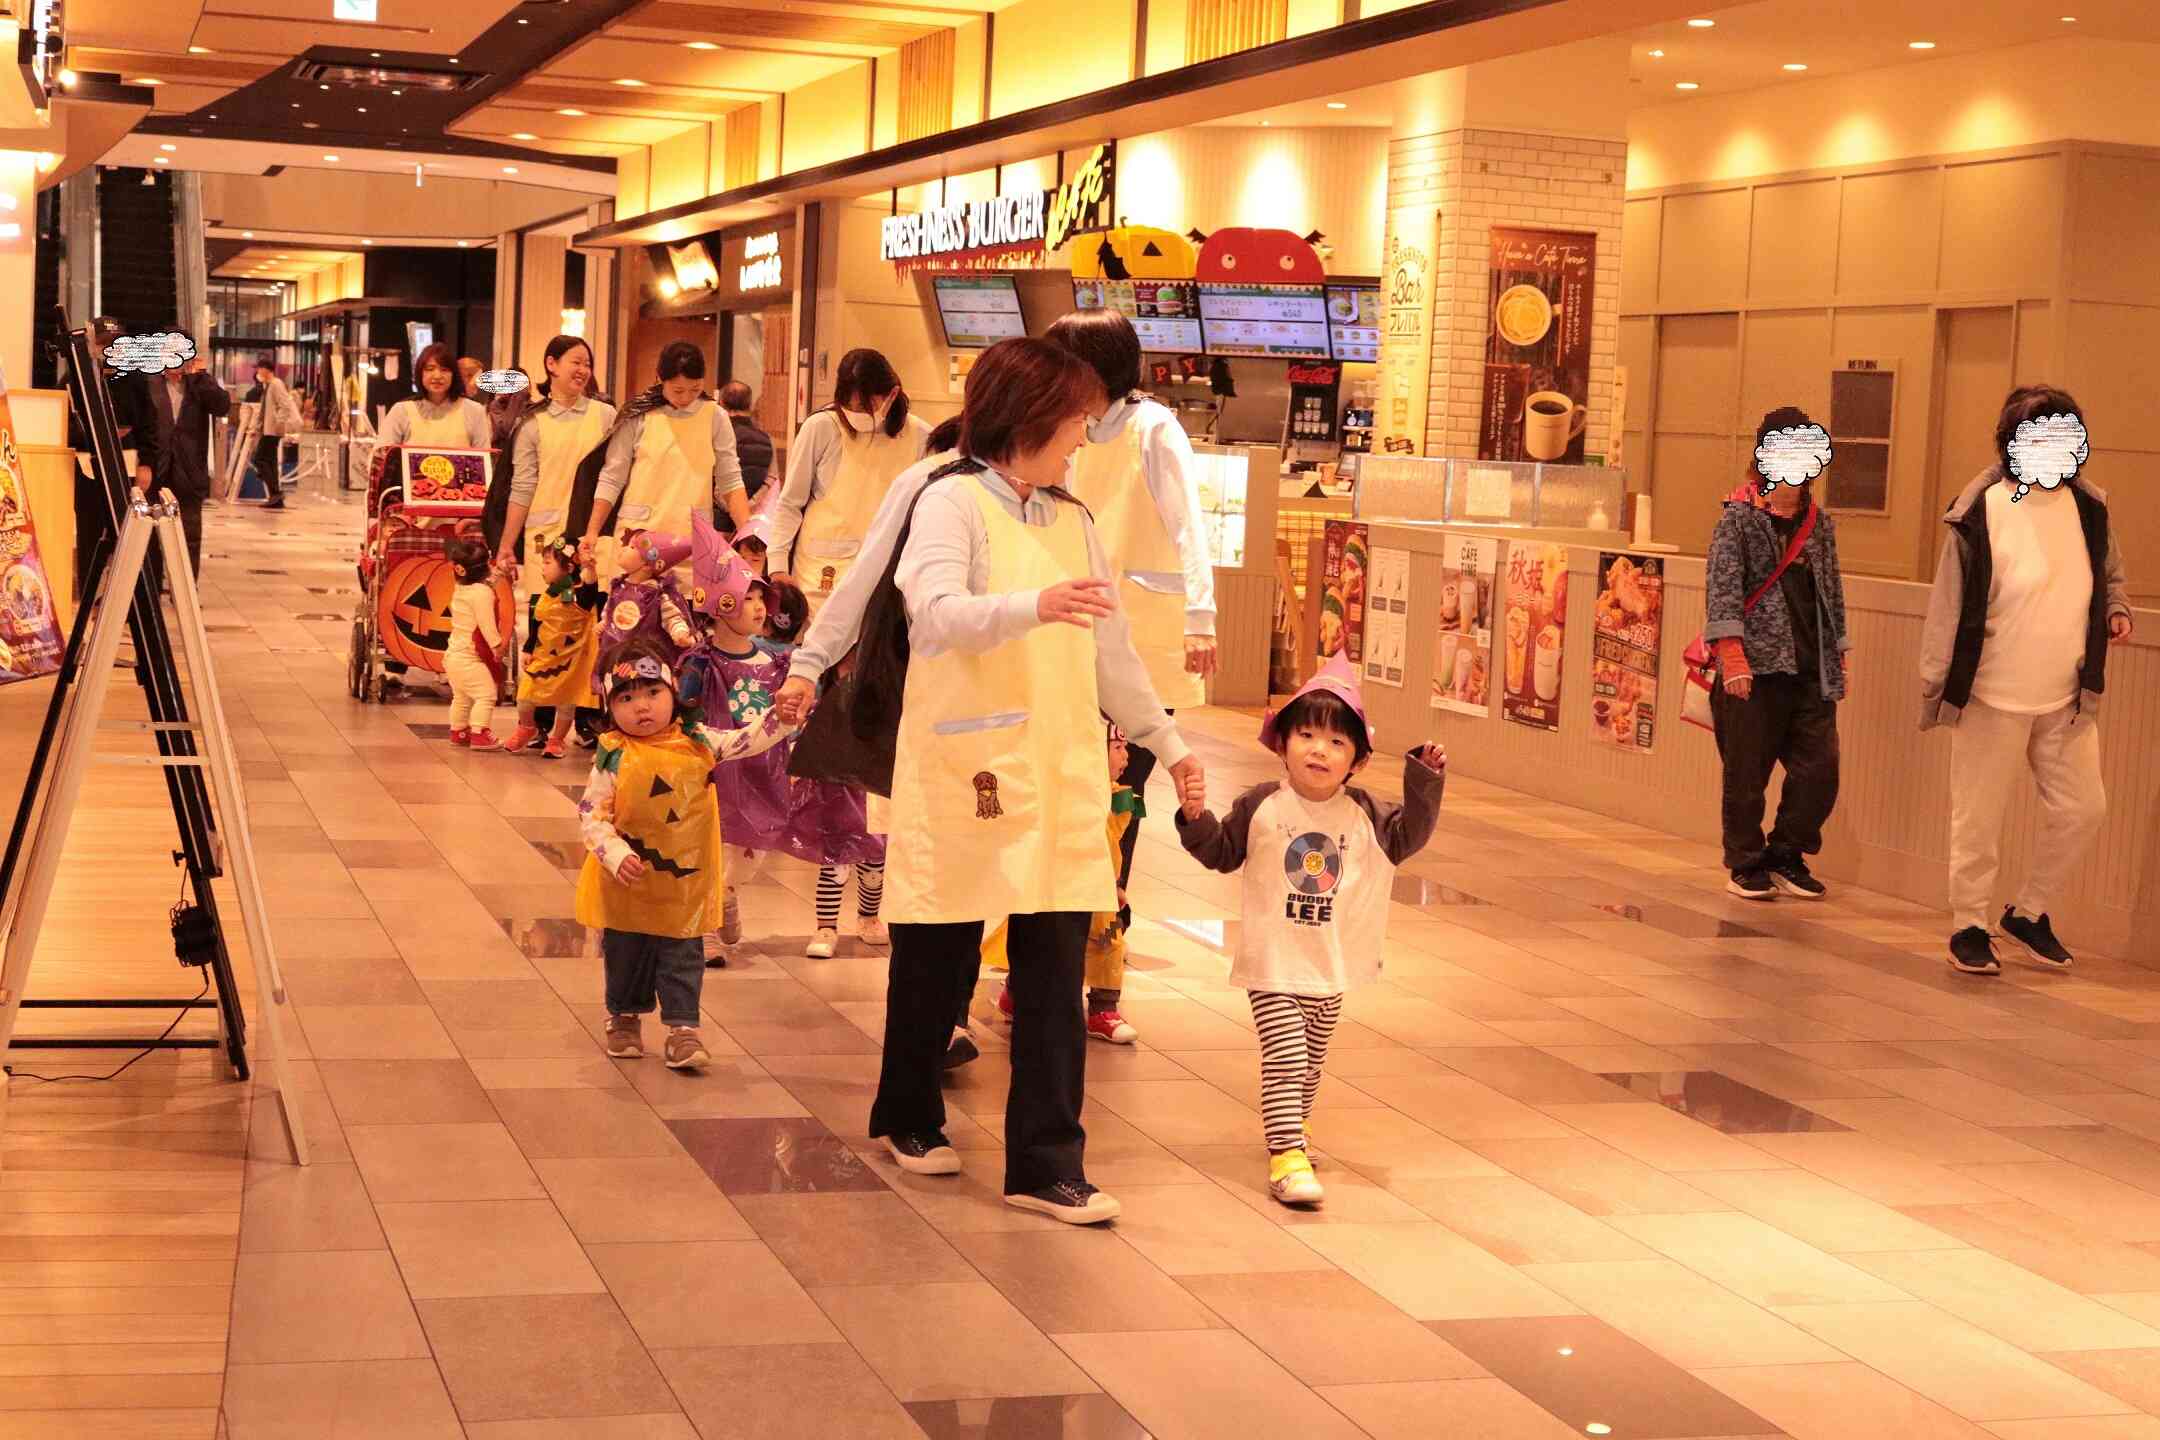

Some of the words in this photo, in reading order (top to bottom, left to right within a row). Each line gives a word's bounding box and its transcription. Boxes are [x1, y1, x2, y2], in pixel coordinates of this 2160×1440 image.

[880, 207, 967, 261] FRESHNESS
[967, 189, 1046, 249] BURGER
[1286, 363, 1338, 385] Coca-Cola
[1287, 893, 1333, 906] BUDDY
[1286, 902, 1332, 922] LEE
